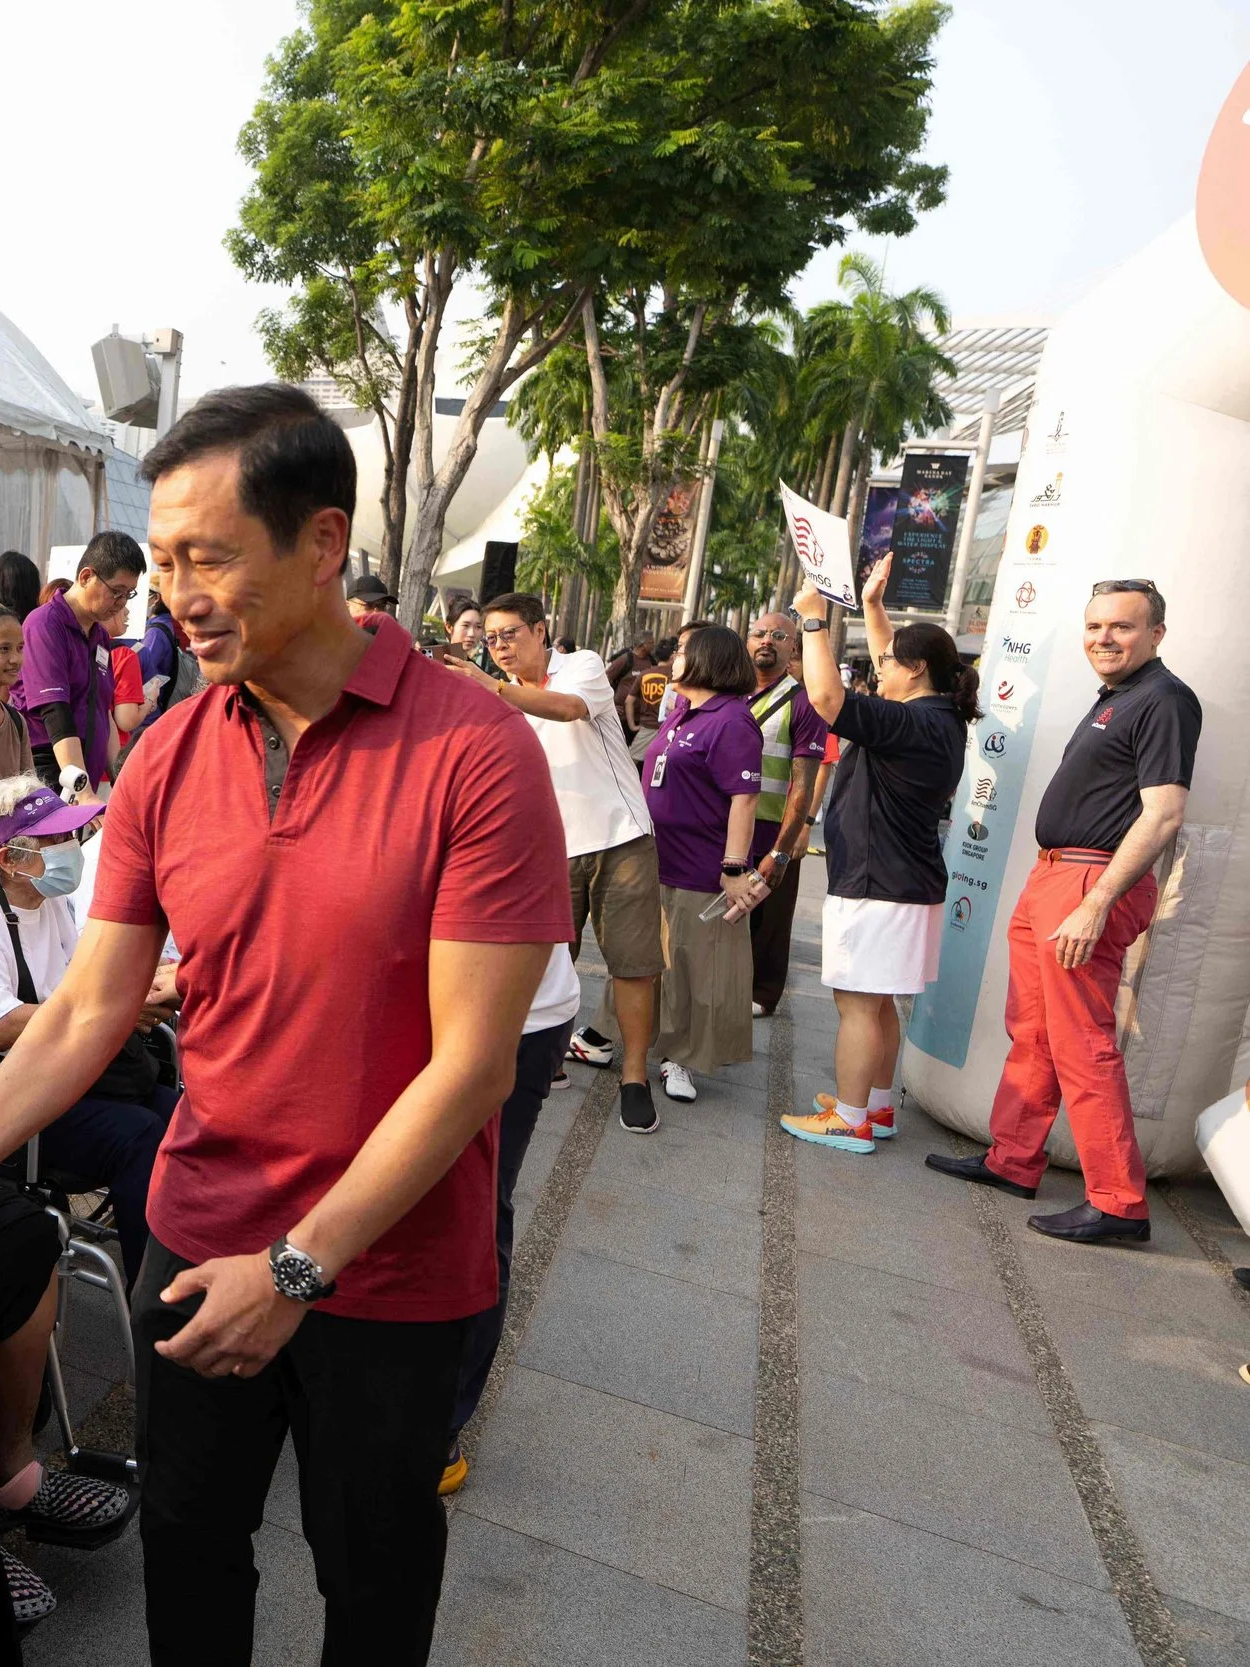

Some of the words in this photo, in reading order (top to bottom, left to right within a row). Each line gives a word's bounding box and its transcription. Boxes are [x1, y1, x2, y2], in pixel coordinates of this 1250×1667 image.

[1007, 641, 1031, 654] NHG
[1005, 654, 1028, 664] Health
[643, 683, 664, 699] ups
[973, 844, 988, 853] GROUP
[962, 848, 985, 861] SINGAPORE
[825, 1127, 856, 1136] HOKA
